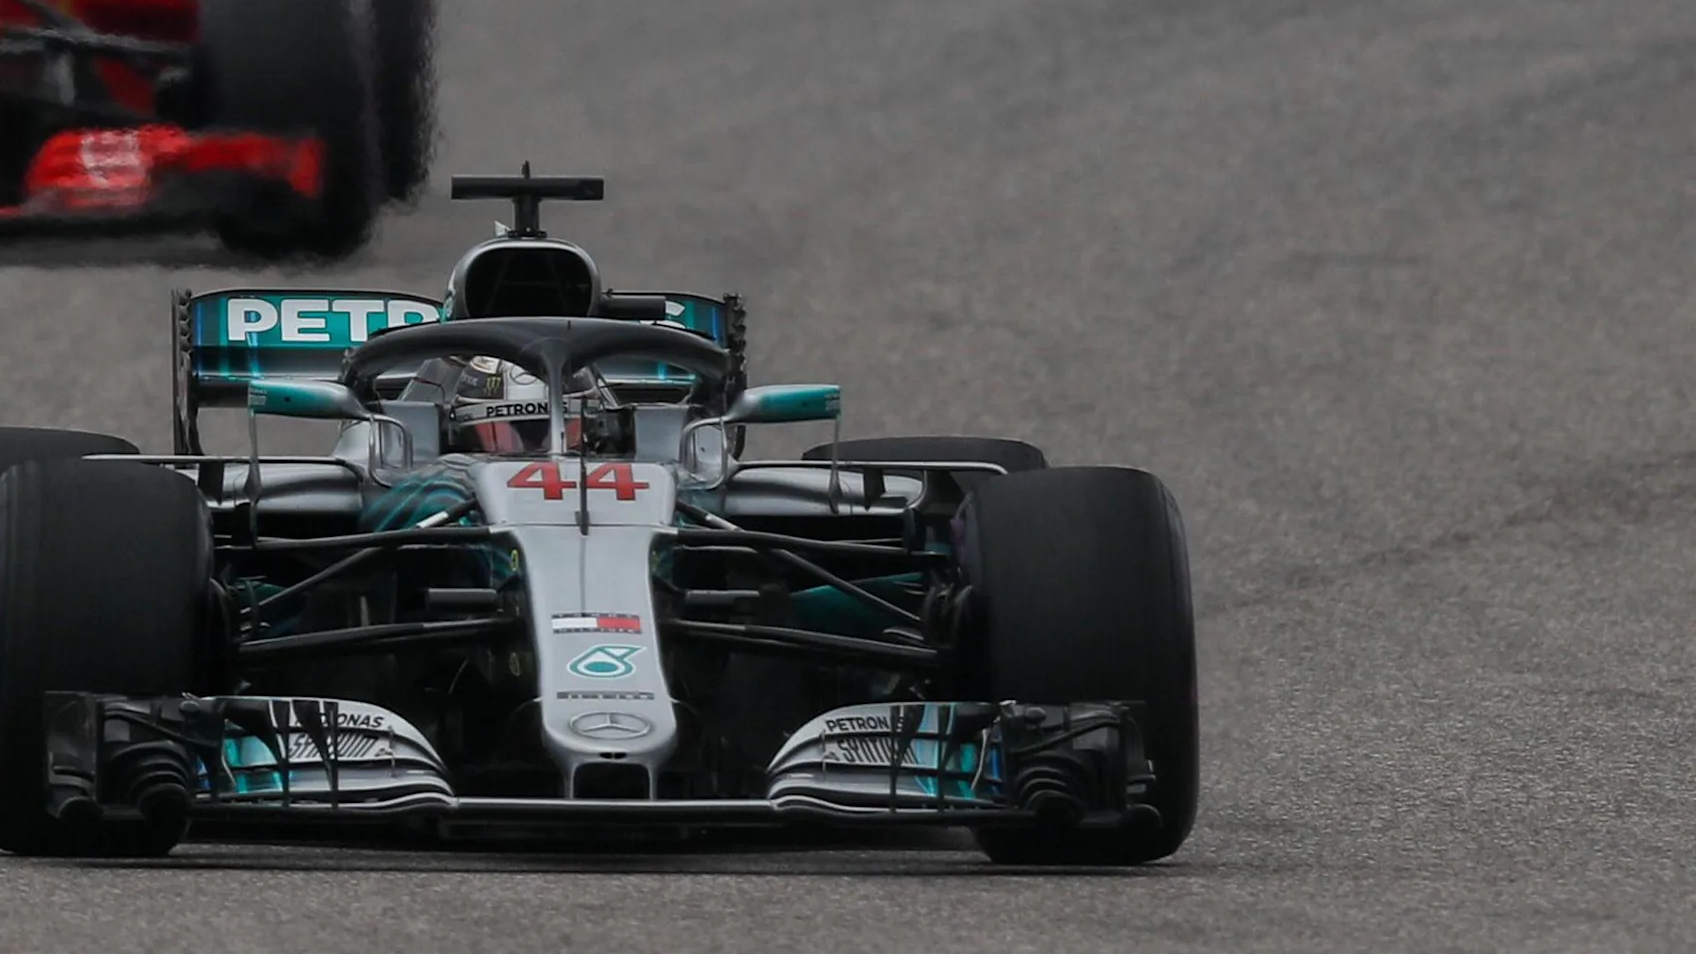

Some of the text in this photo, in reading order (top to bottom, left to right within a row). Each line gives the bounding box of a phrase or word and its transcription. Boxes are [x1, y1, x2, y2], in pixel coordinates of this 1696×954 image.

[486, 402, 568, 418] PETRONS
[507, 461, 650, 501] 44
[825, 715, 905, 732] PETRON
